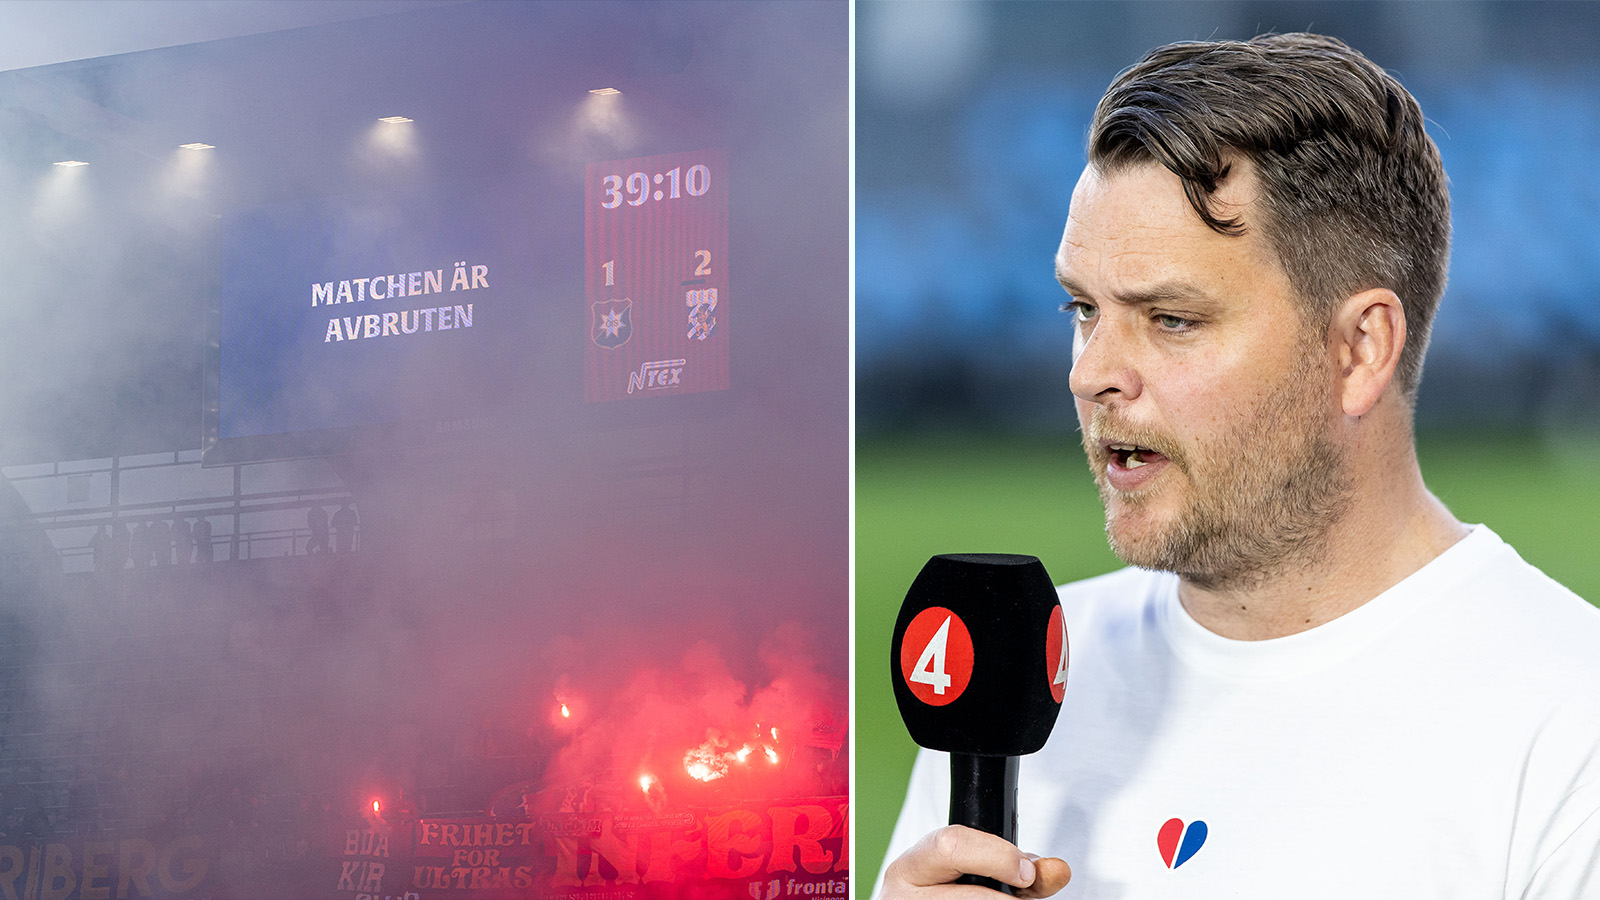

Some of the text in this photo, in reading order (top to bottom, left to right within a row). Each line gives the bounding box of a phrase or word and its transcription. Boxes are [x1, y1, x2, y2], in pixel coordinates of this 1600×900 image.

[601, 164, 711, 209] 39:10
[602, 260, 615, 286] 1
[694, 249, 712, 276] 2
[311, 261, 490, 307] MATCHEN ÄR
[324, 303, 475, 343] AVBRUTEN
[627, 358, 686, 394] NTEX
[909, 615, 952, 696] 4
[420, 822, 536, 847] FRIHET
[413, 866, 533, 890] ULTRAS
